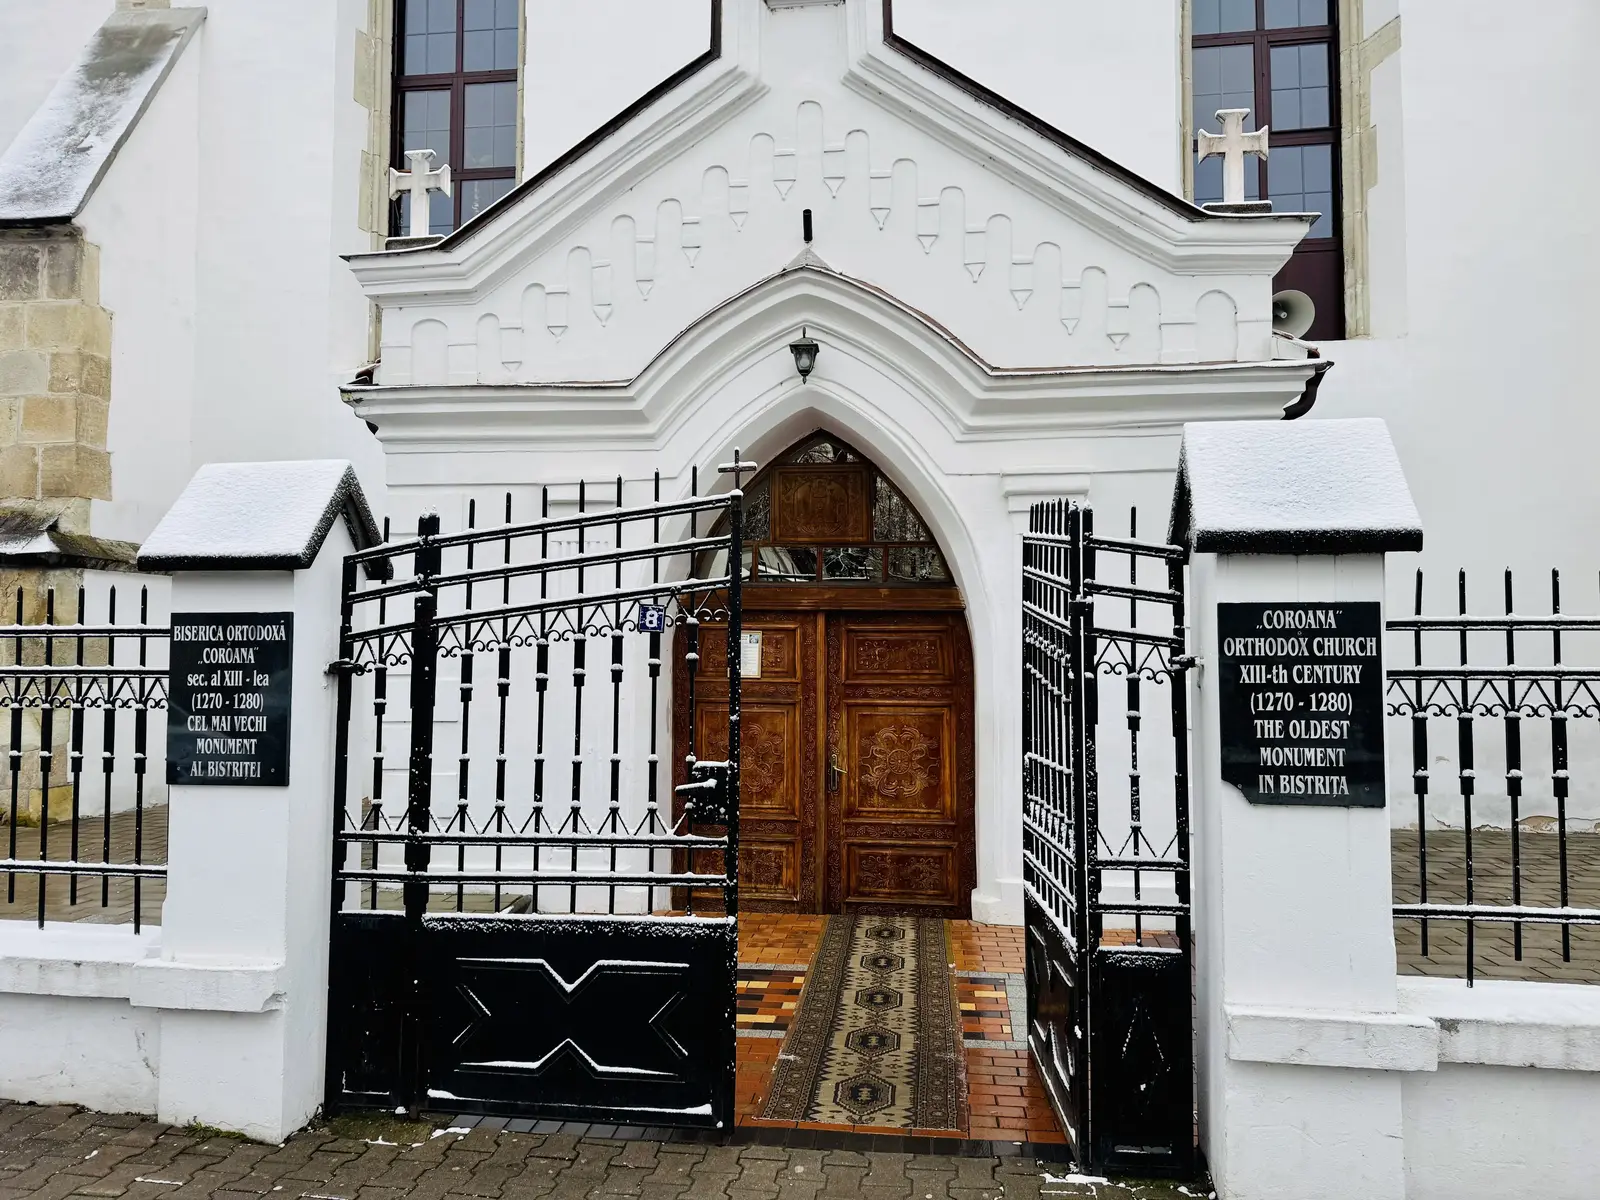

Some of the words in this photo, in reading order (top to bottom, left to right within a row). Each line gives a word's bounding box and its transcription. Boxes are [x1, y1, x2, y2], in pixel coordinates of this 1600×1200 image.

[174, 625, 223, 641] BISERICA
[227, 620, 286, 641] ORTODOXĂ
[1224, 637, 1309, 656] ORTHODOX
[1313, 637, 1377, 656] CHURCH
[187, 673, 208, 686] sec.
[211, 671, 220, 686] al
[224, 671, 242, 686] XIII
[253, 671, 269, 686] lea
[1240, 664, 1288, 683] XIII-th
[1293, 665, 1362, 683] CENTURY
[192, 693, 222, 712] (1270
[233, 693, 263, 712] 1280)
[1251, 692, 1293, 714] (1270
[1309, 692, 1352, 715] 1280)
[187, 716, 208, 731] CEL
[211, 716, 230, 731] MAI
[234, 716, 267, 731] VECHI
[1254, 720, 1284, 738] THE
[1289, 720, 1350, 739] OLDEST
[197, 739, 257, 754] MONUMENT
[1260, 747, 1345, 767] MONUMENT
[190, 761, 204, 776] AL
[1259, 775, 1274, 793] IN
